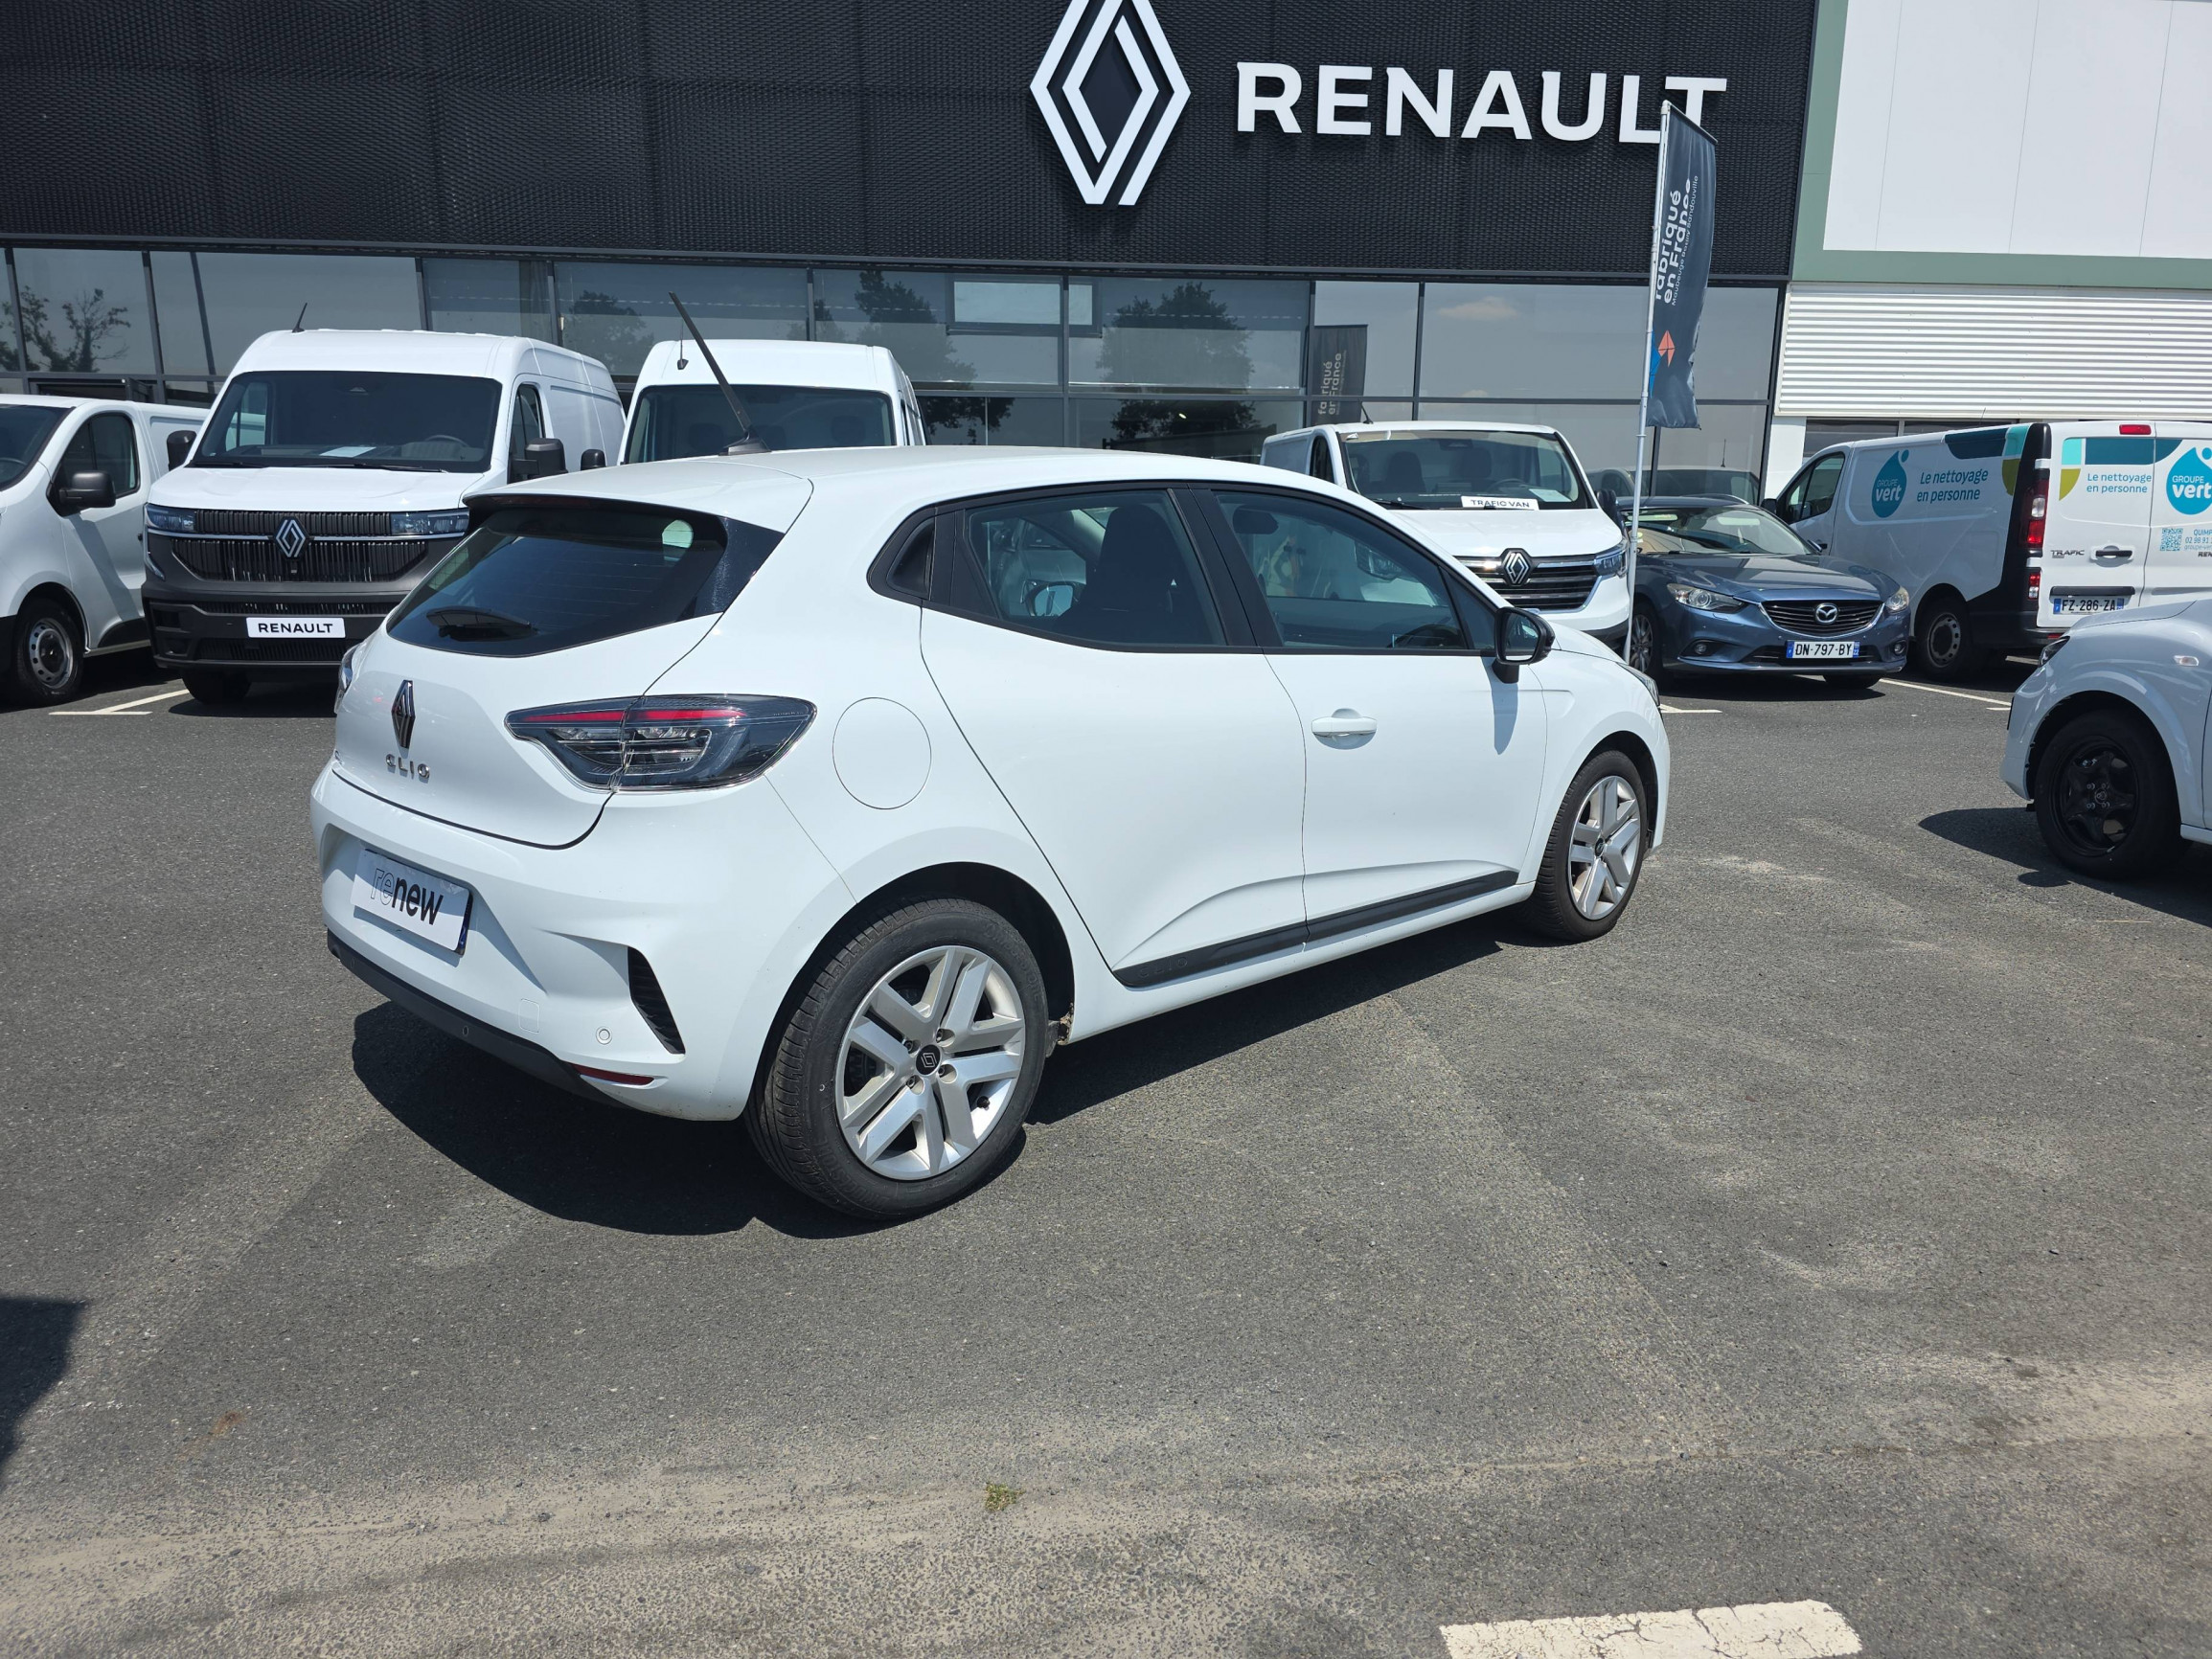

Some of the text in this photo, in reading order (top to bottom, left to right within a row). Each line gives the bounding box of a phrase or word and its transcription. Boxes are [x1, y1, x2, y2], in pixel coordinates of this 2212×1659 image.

[1236, 61, 1727, 144] RENAULT
[1664, 273, 1676, 304] en
[1317, 361, 1333, 415] fariqué
[1920, 467, 1989, 485] Le nettoyage
[2087, 473, 2152, 484] Le nettoyage
[1876, 485, 1903, 502] vert
[1917, 489, 1981, 504] en personne
[2101, 485, 2148, 493] personne
[2172, 482, 2212, 498] vert
[2062, 599, 2116, 611] FZ-286-ZA
[258, 623, 333, 633] RENAULT
[1794, 643, 1853, 656] DN-797-BY
[385, 753, 430, 779] CLIO
[370, 867, 445, 926] renew
